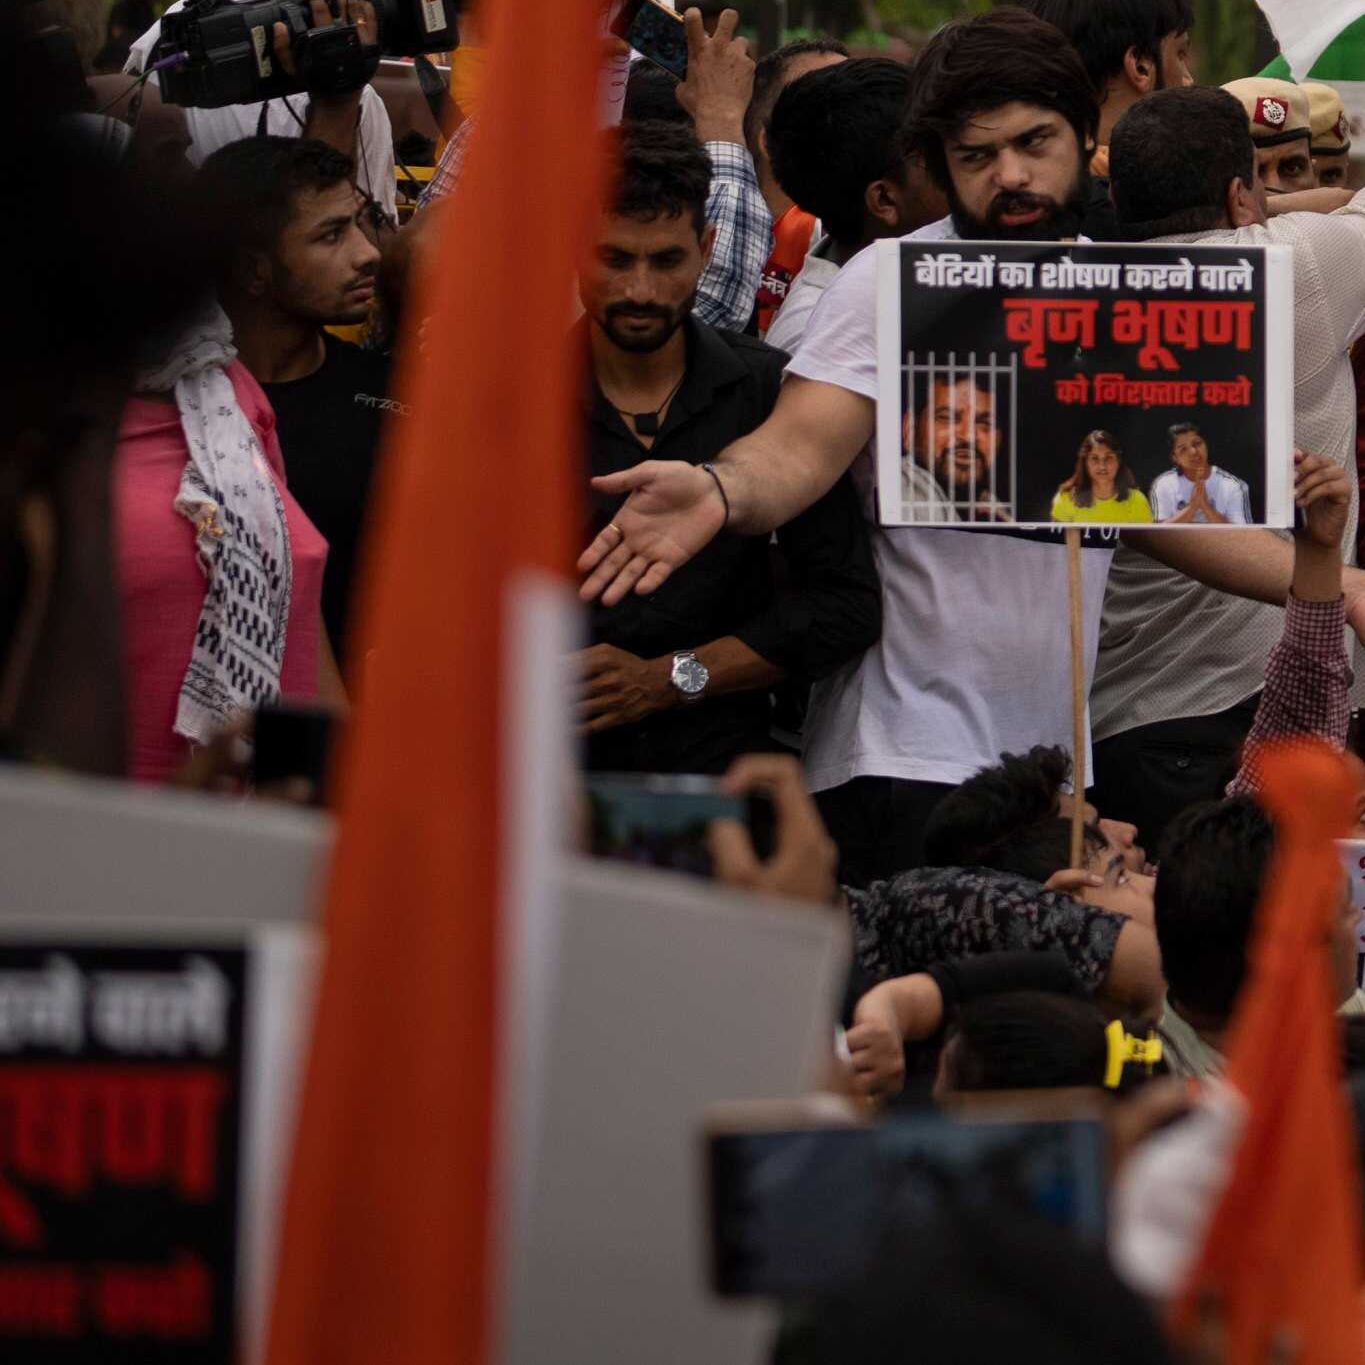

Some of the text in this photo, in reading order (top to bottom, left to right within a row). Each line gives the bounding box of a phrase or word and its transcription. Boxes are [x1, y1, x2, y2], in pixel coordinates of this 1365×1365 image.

[914, 253, 1255, 291] बेटियों का शोषण करने वाले
[1002, 298, 1255, 371] बृज भूषण
[1055, 372, 1089, 405] को
[1203, 374, 1251, 406] करो
